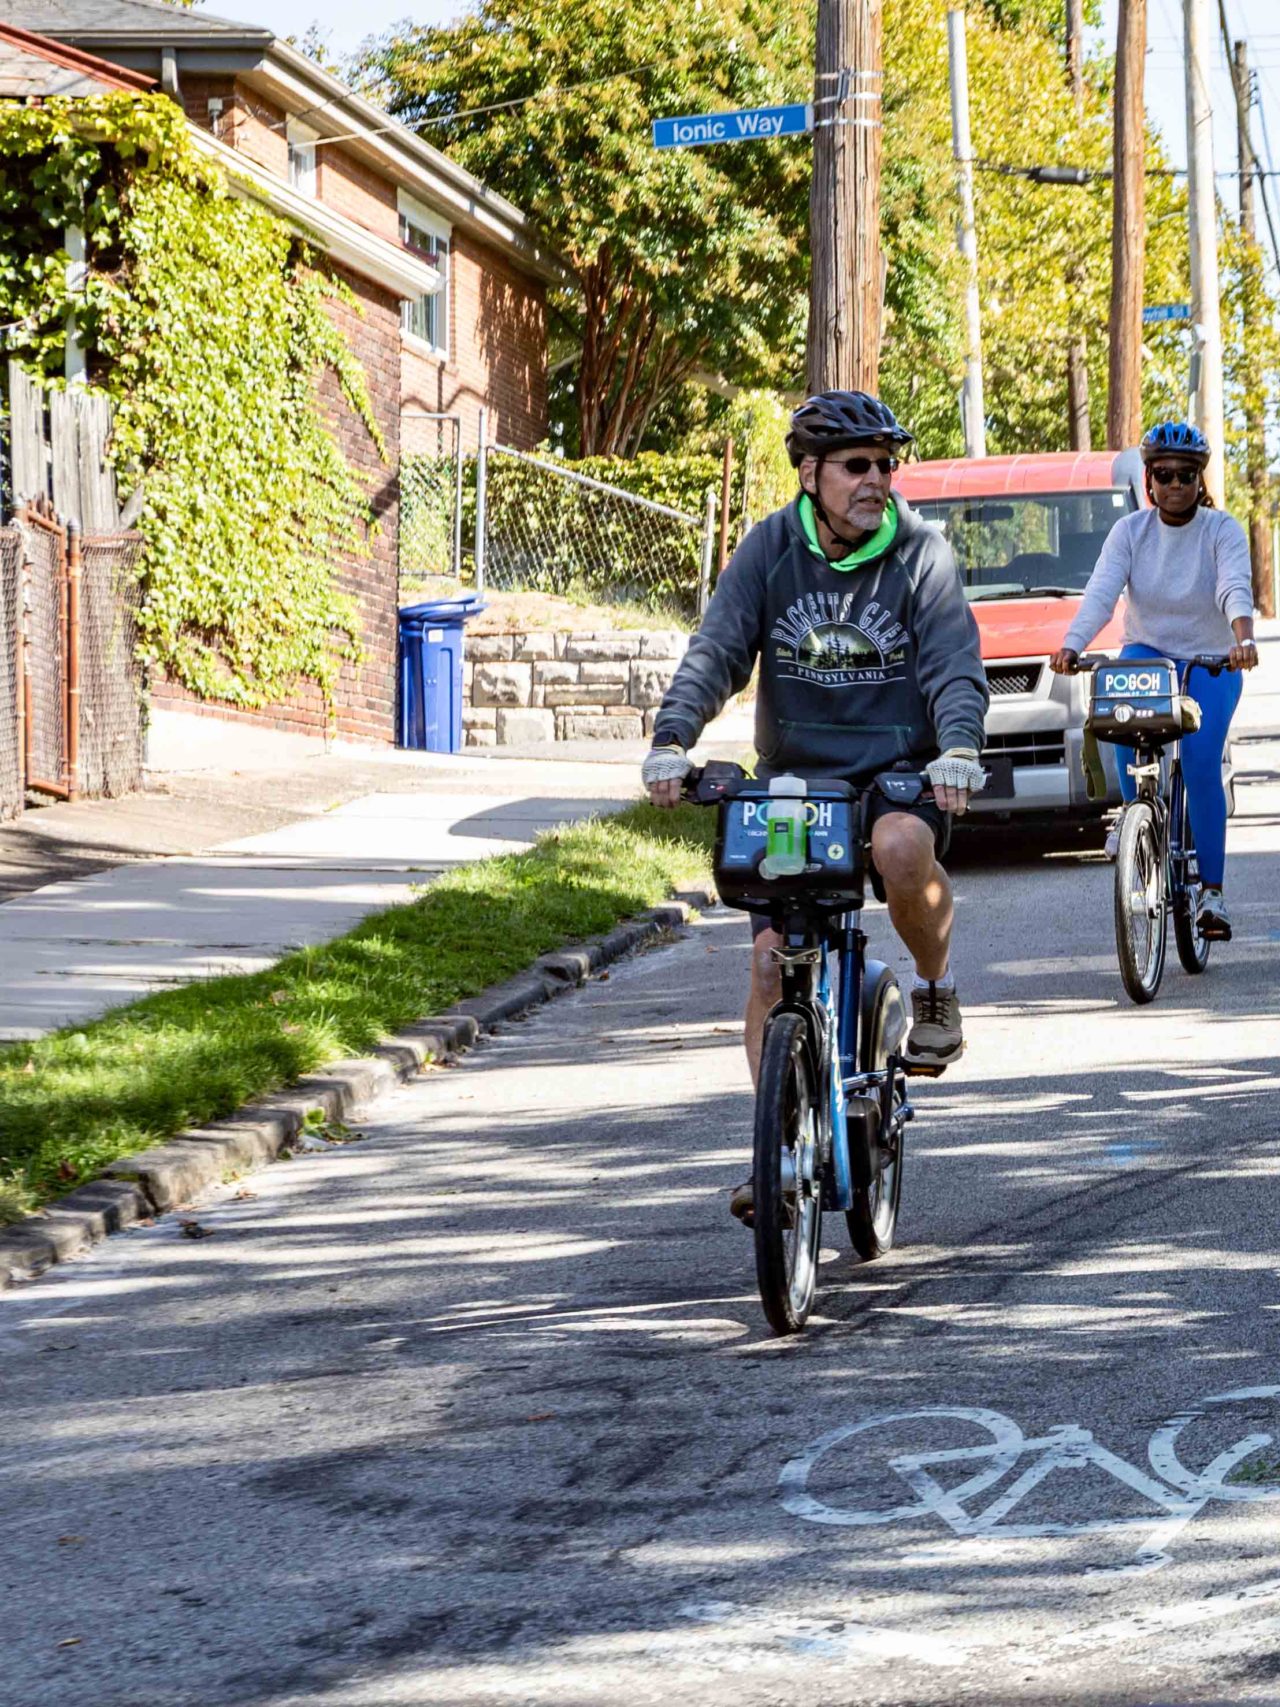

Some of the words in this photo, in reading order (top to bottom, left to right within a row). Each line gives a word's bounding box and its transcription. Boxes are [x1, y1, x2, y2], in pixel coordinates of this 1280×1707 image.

[672, 118, 726, 142] Ionic
[735, 113, 784, 135] Way
[797, 667, 886, 682] PENNSYLVANIA
[1105, 673, 1160, 691] POGOH
